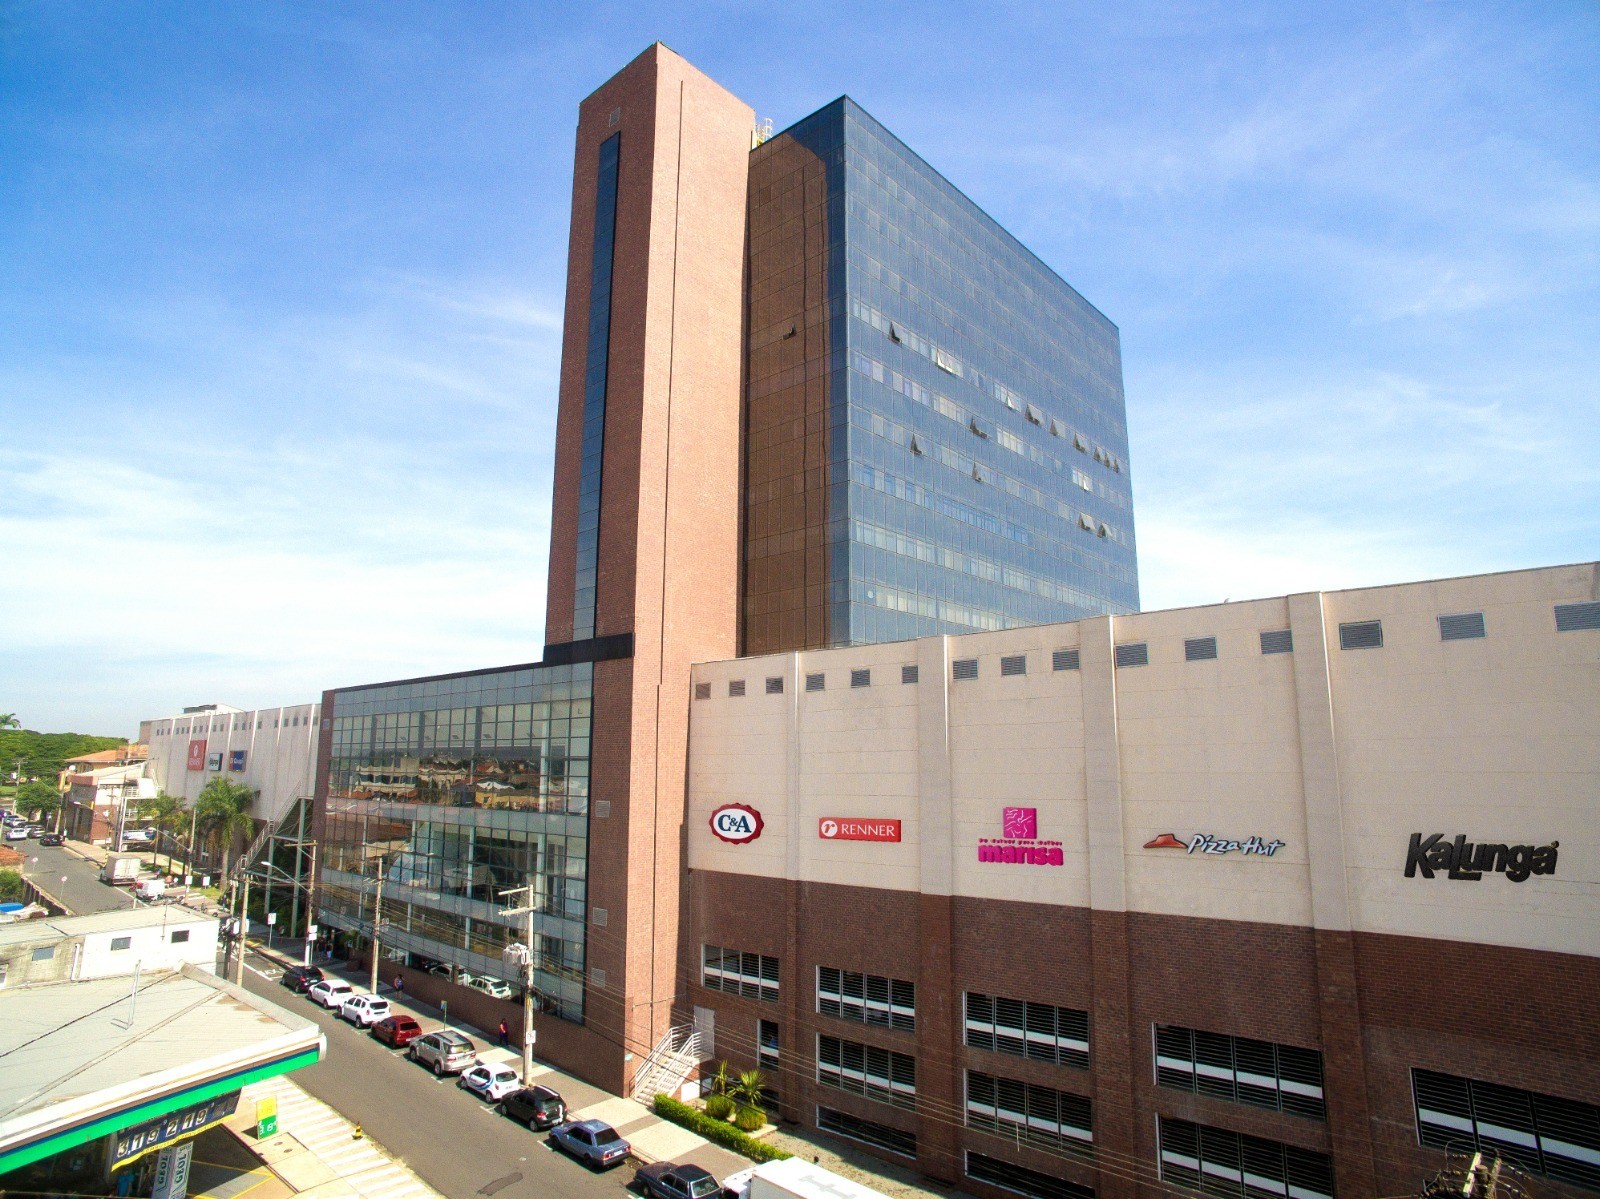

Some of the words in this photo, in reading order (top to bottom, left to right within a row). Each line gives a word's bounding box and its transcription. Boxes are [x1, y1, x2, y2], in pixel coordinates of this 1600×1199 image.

[717, 814, 752, 833] C&A
[841, 823, 895, 837] RENNER
[1187, 833, 1241, 854] Pizza
[1241, 836, 1285, 856] Hut
[978, 845, 1063, 866] marisa
